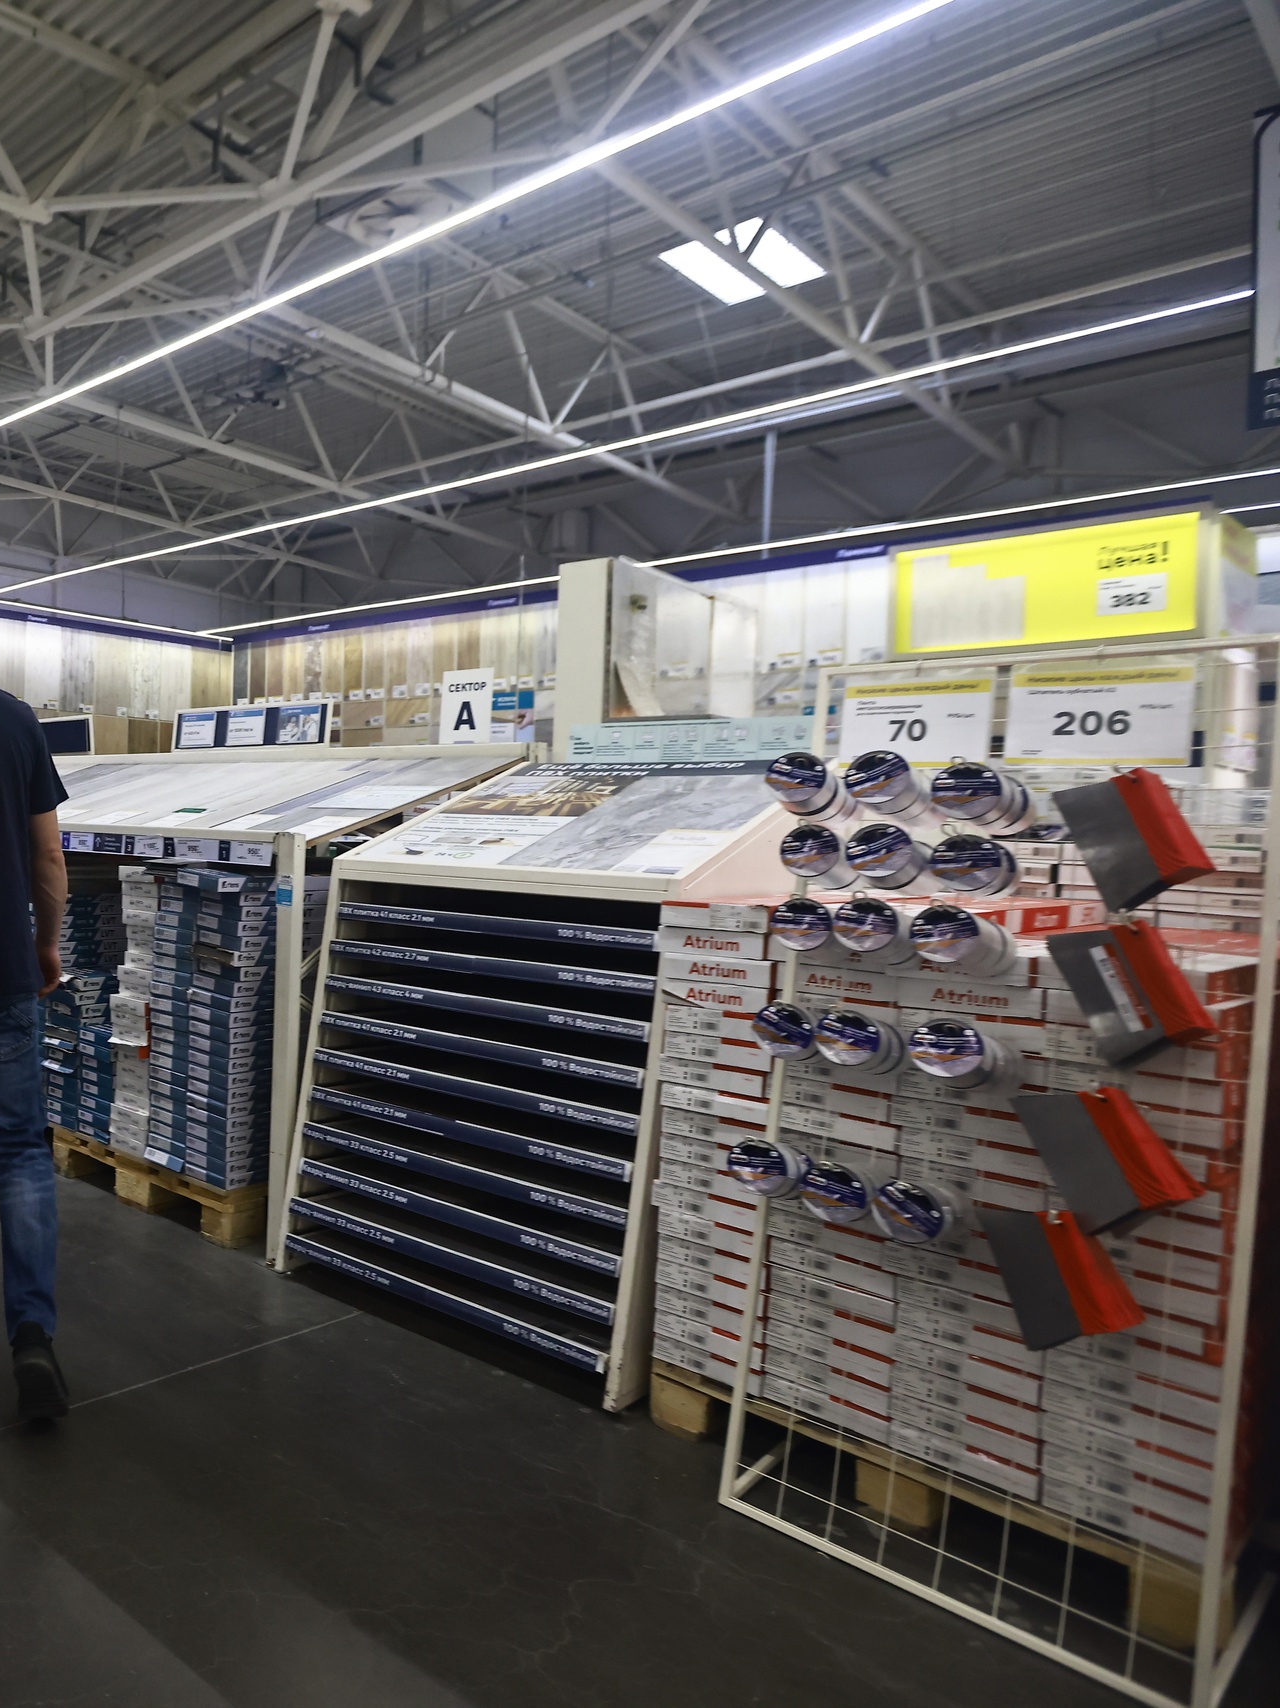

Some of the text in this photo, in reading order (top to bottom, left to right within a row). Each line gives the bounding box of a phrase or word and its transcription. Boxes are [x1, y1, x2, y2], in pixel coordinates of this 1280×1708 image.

[448, 681, 487, 693] СЕКТОР
[888, 718, 927, 743] 70
[1052, 709, 1132, 737] 206
[537, 761, 746, 772] Ещё больше выбор
[338, 906, 353, 914] ПВХ
[353, 909, 379, 917] плитка
[389, 912, 410, 920] класс
[557, 929, 652, 945] 100 % Водостойкий
[682, 935, 740, 951] Atrium
[331, 943, 345, 952] ПВХ
[345, 946, 371, 955] плитка
[382, 950, 404, 959] класс
[557, 971, 654, 990] 100 % Водостойкий
[688, 962, 747, 979] Atrium
[326, 979, 371, 991] Кварц-винил
[382, 987, 404, 997] класс
[410, 992, 423, 1000] мм
[805, 973, 872, 993] Atrium
[686, 987, 743, 1005] Atrium
[930, 987, 1009, 1009] Atrium
[320, 1015, 335, 1024] ПВХ
[335, 1019, 361, 1029] плитка
[370, 1026, 393, 1035] класс
[548, 1014, 643, 1036] 100 % Водостойкий
[314, 1052, 329, 1061] ПВХ
[329, 1057, 354, 1068] плитка
[363, 1064, 386, 1075] класс
[397, 1072, 410, 1080] мм
[541, 1058, 637, 1082] 100 % Водостойкий
[312, 1090, 326, 1100] ПВХ
[326, 1095, 352, 1106] плитка
[361, 1103, 383, 1114] класс
[394, 1111, 407, 1119] мм
[539, 1102, 635, 1130] 100 % Водостойкий
[302, 1127, 349, 1146] Кварц-винил
[349, 1141, 359, 1149] 33
[360, 1144, 382, 1156] класс
[395, 1154, 408, 1163] мм
[528, 1145, 623, 1174] 100 % Водостойкий
[302, 1164, 349, 1184] Кварц-винил
[349, 1180, 359, 1188] 33
[359, 1183, 382, 1195] класс
[394, 1195, 408, 1204] мм
[530, 1191, 626, 1224] 100 % Водостойкий
[290, 1203, 336, 1223] Кварц-винил
[336, 1219, 346, 1227] 33
[346, 1222, 369, 1235] класс
[381, 1235, 395, 1244] мм
[285, 1240, 332, 1263] Кварц-винил
[332, 1257, 342, 1266] 33
[342, 1262, 364, 1276] класс
[377, 1276, 390, 1286] мм
[520, 1234, 616, 1271] 100 % Водостойкий
[513, 1279, 609, 1317] 100 % Водостойкий
[503, 1323, 597, 1364] 100 % Водостойкий
